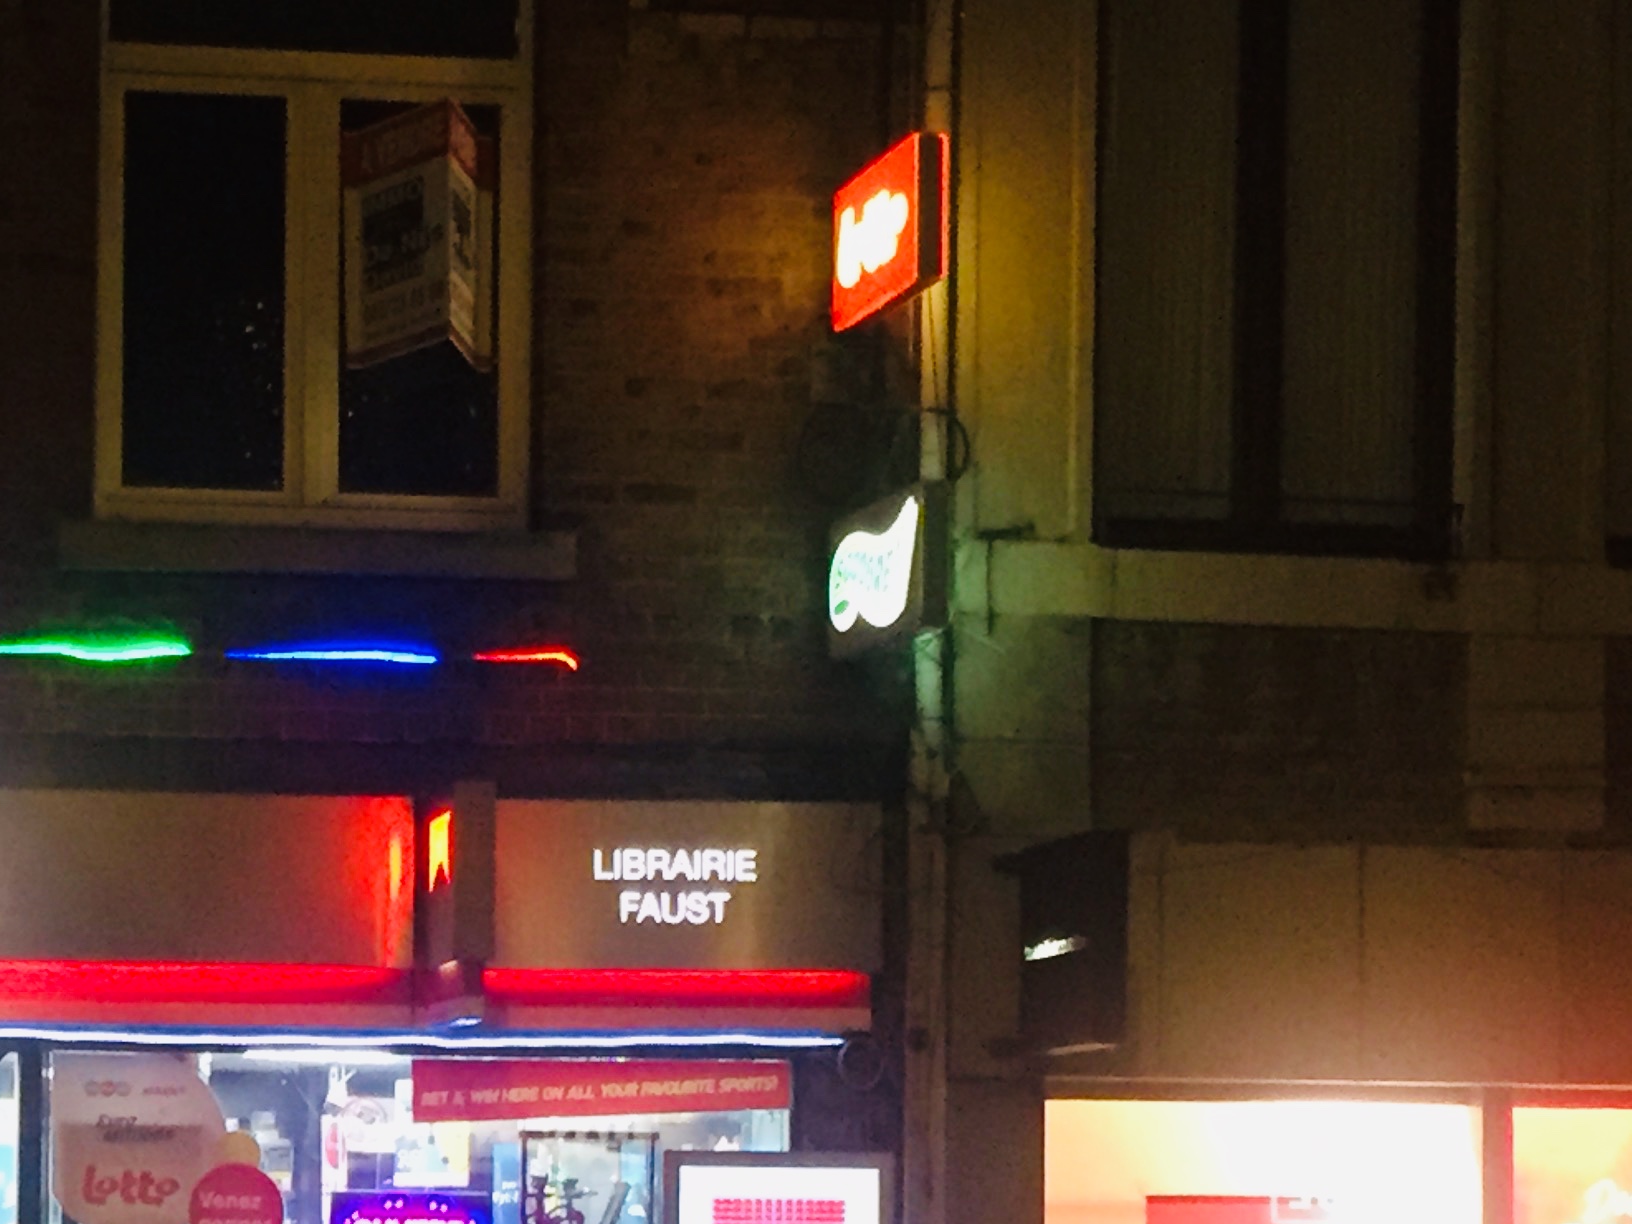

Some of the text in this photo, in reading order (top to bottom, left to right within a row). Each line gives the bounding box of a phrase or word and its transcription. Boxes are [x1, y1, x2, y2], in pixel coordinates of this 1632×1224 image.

[592, 848, 758, 882] LIBRAIRIE
[618, 890, 732, 925] FAUST
[566, 1083, 594, 1101] ALL
[600, 1082, 638, 1098] YOUR
[198, 1191, 262, 1210] Venez
